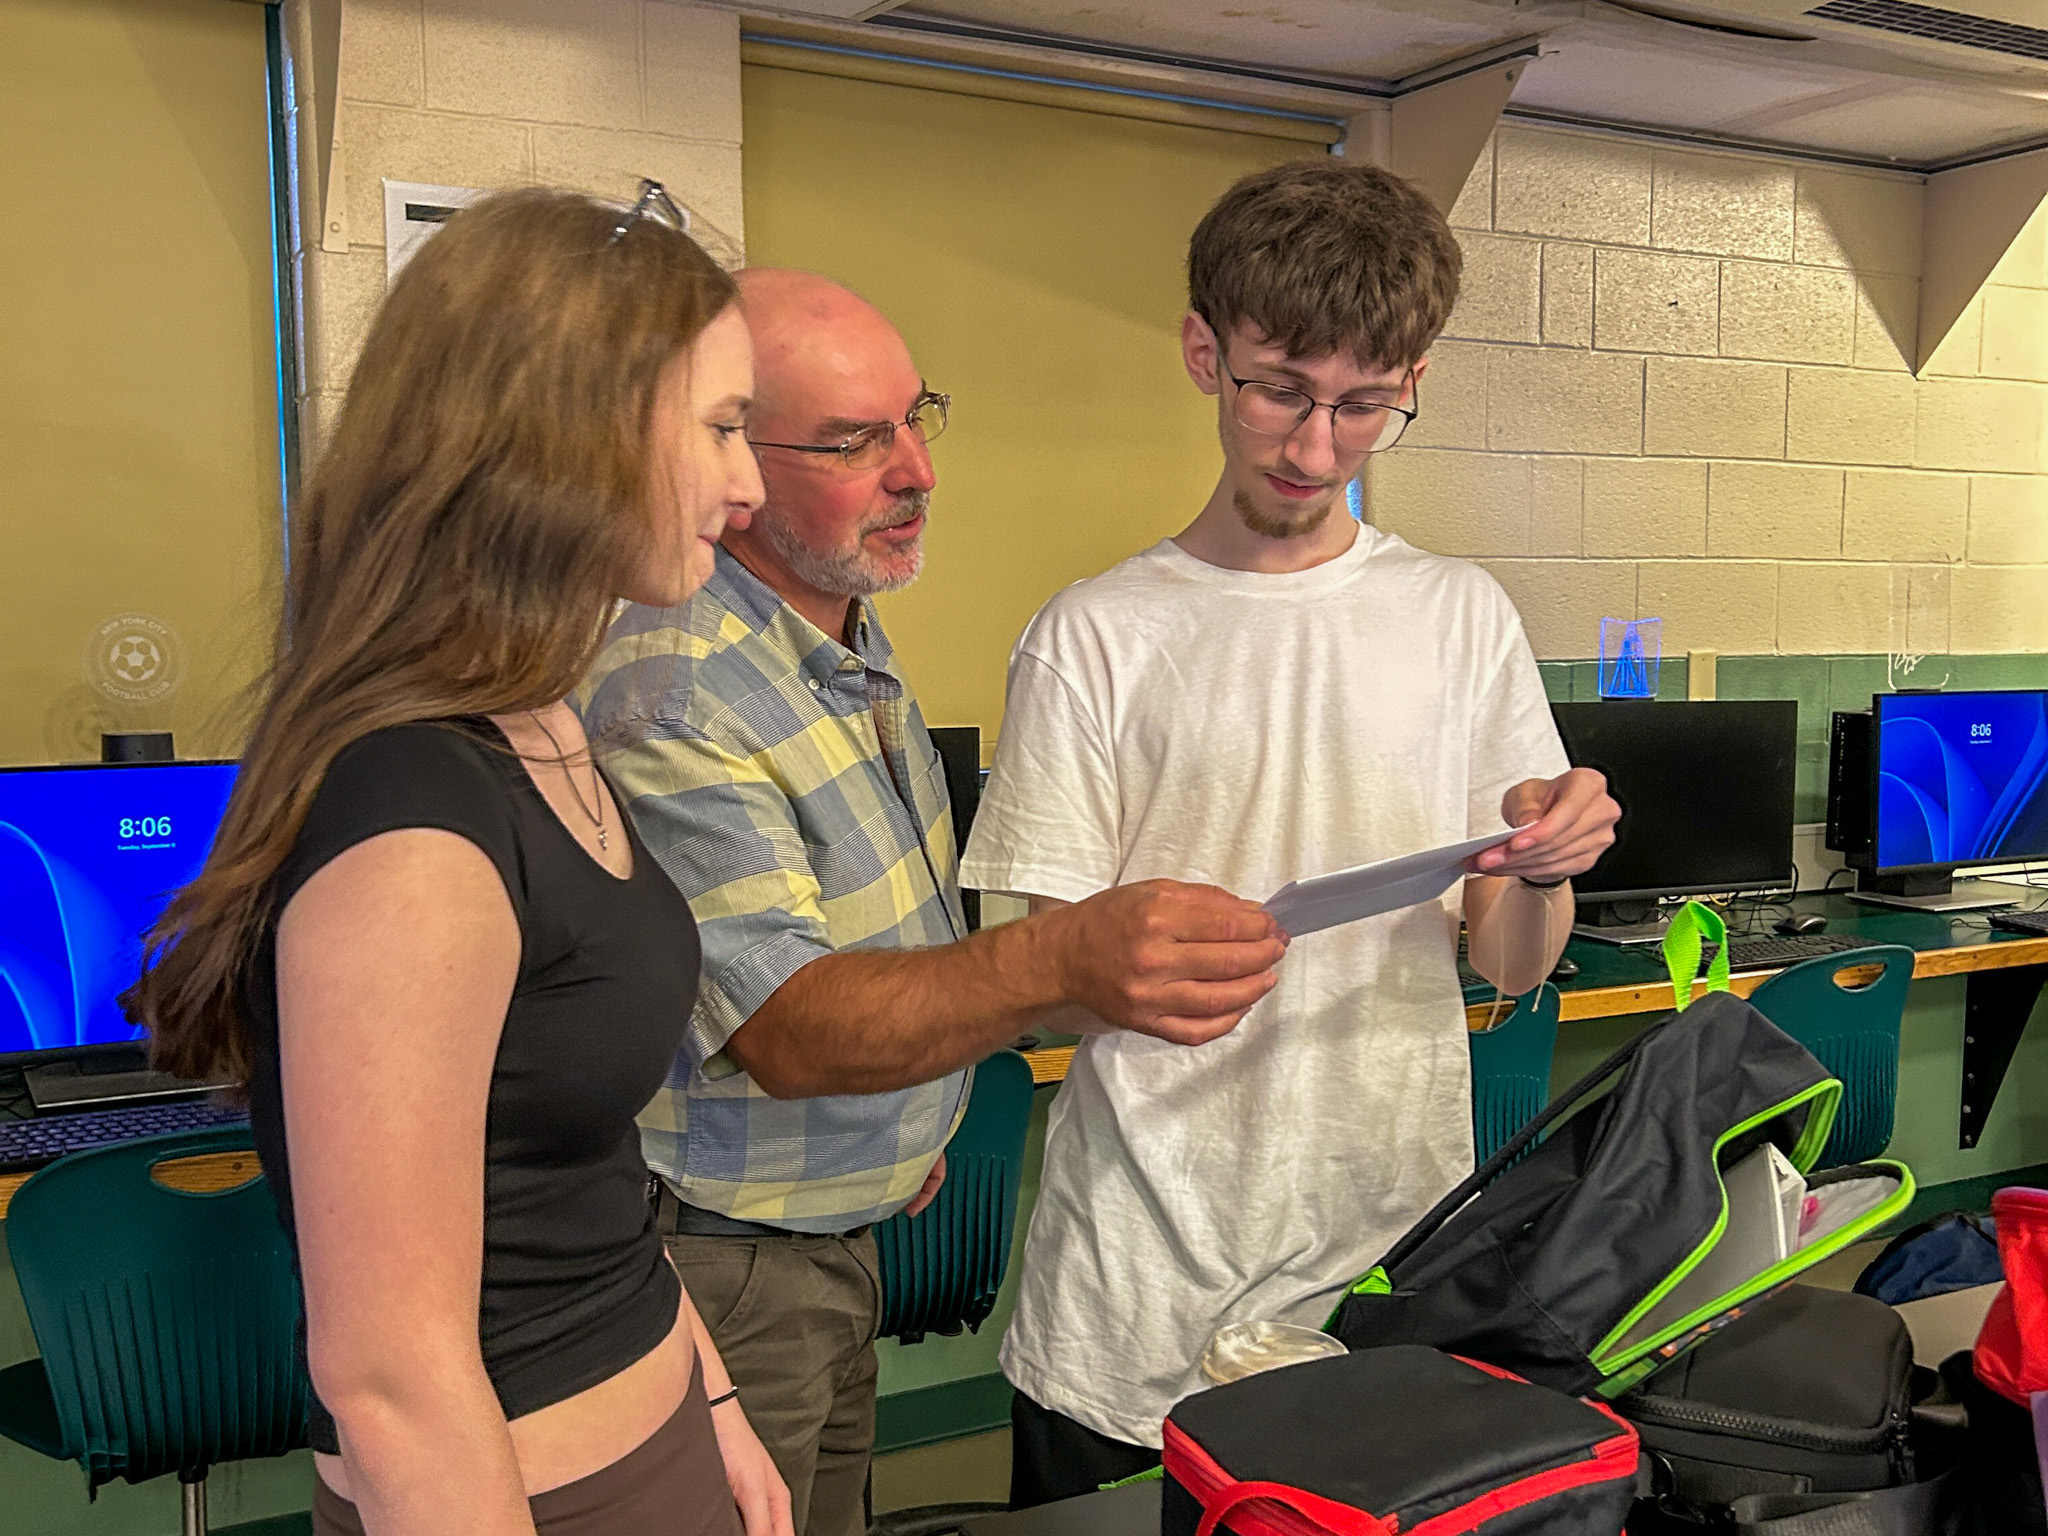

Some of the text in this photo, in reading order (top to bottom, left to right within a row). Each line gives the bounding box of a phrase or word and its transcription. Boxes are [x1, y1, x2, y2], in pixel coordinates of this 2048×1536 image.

[122, 617, 147, 625] YORK
[149, 621, 168, 635] CITY
[102, 681, 170, 700] FOOTBALL CLUB
[1971, 723, 1992, 737] 8:06
[119, 816, 172, 838] 8:06
